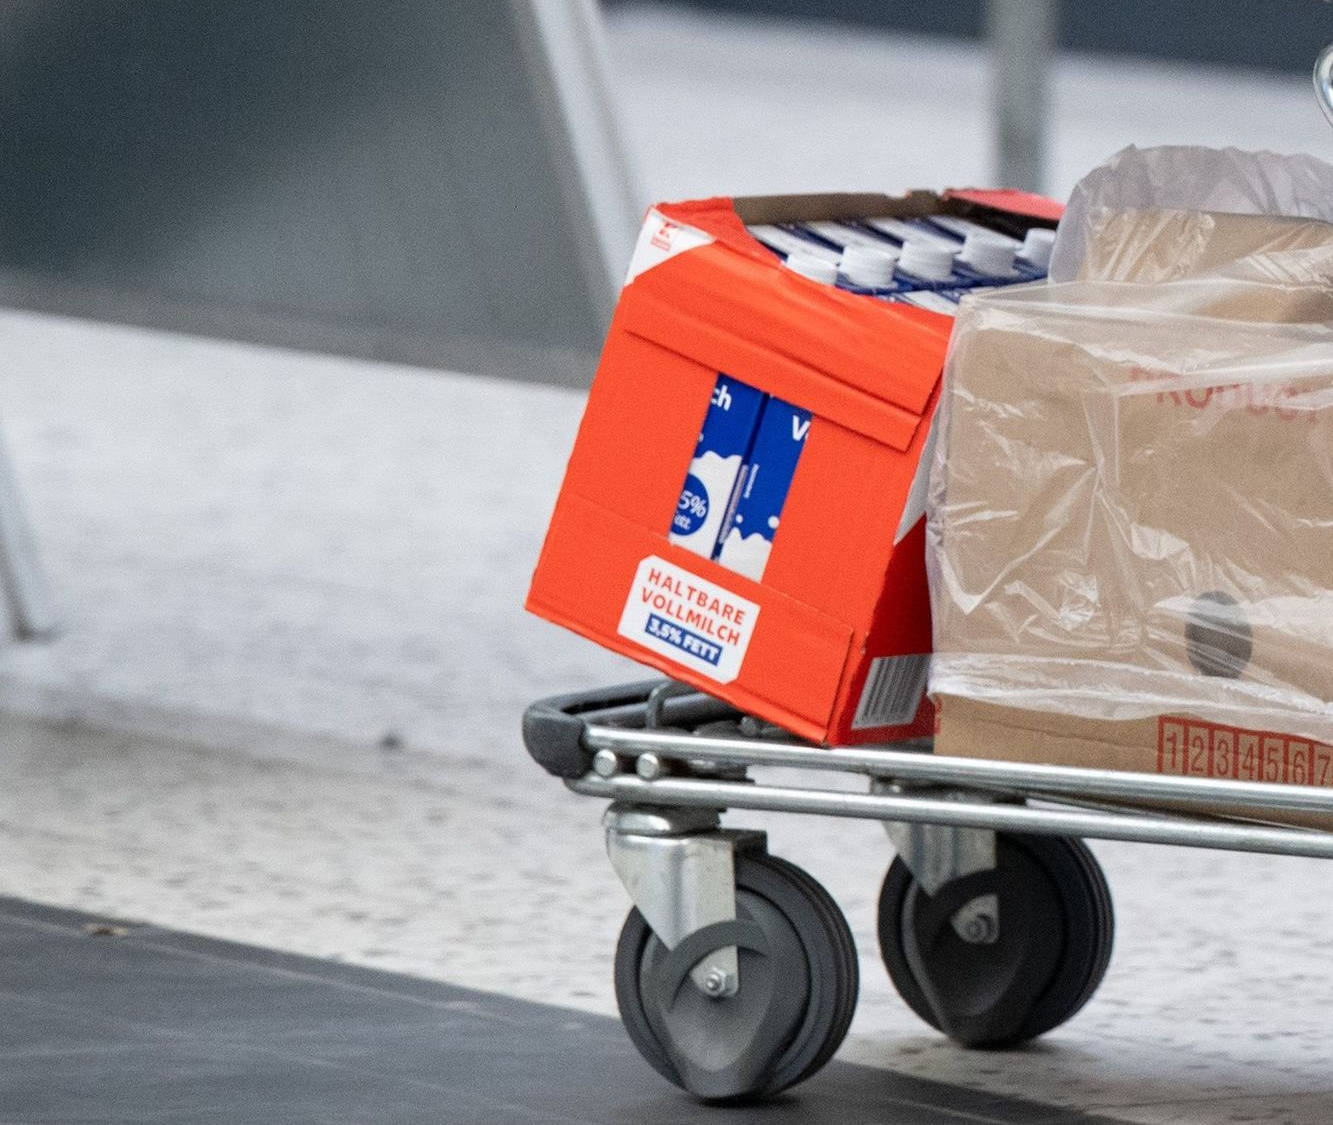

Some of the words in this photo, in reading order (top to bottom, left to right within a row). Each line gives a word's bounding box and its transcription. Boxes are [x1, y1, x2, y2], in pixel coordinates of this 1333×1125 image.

[641, 586, 741, 647] VOLLMILCH
[648, 567, 746, 626] HALTBARE
[682, 633, 720, 662] FETT
[1166, 731, 1177, 769] 1
[1191, 735, 1204, 772] 2
[1216, 739, 1229, 775] 3
[1242, 743, 1255, 779] 4
[1266, 747, 1279, 782] 5
[1292, 750, 1306, 785] 6
[1317, 753, 1331, 786] 7
